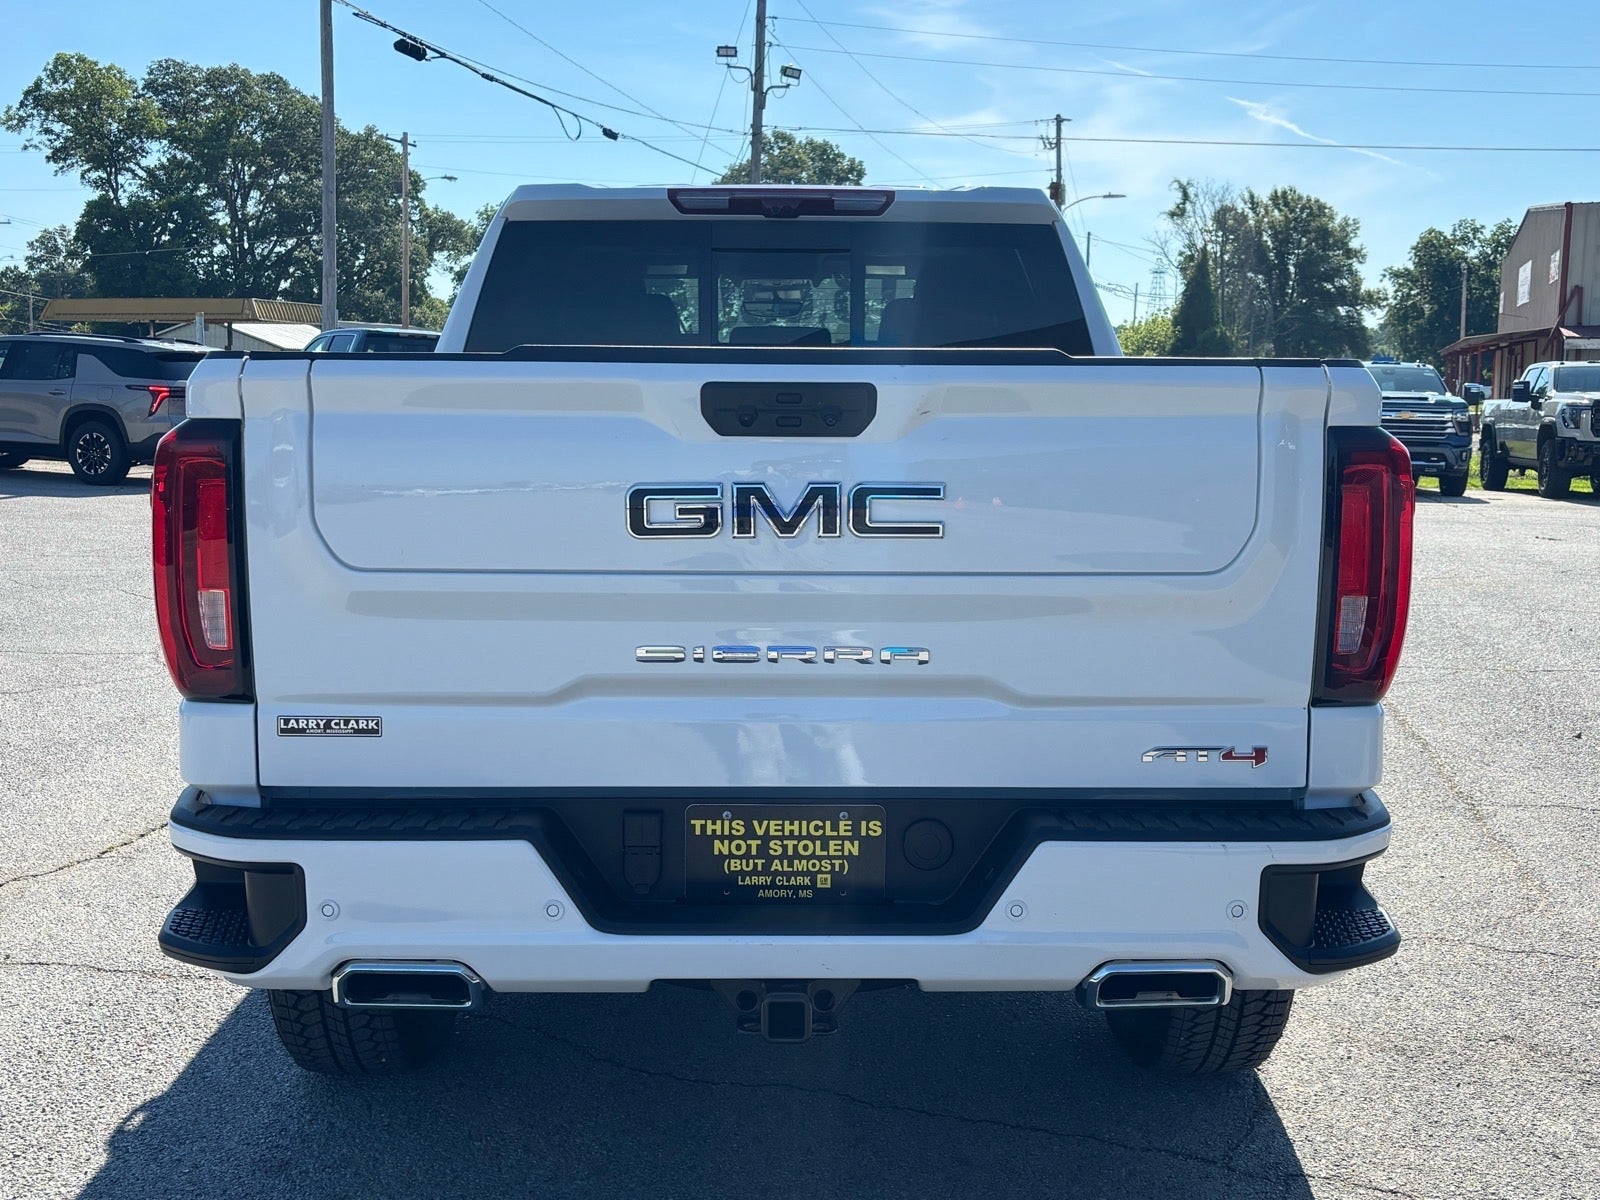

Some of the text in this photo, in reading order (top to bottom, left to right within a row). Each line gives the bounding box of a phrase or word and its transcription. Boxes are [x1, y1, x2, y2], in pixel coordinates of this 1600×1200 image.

[626, 482, 946, 539] GMC
[635, 645, 931, 665] SIERRA
[280, 719, 379, 730] LARRY CLARK
[1142, 746, 1268, 768] AT4
[691, 819, 883, 837] THIS VEHICLE IS
[713, 840, 860, 856] NOT STOLEN
[724, 858, 849, 875] (BUT ALMOST)
[738, 876, 811, 886] LARRY CLARK
[758, 889, 813, 898] AMORY, MS
